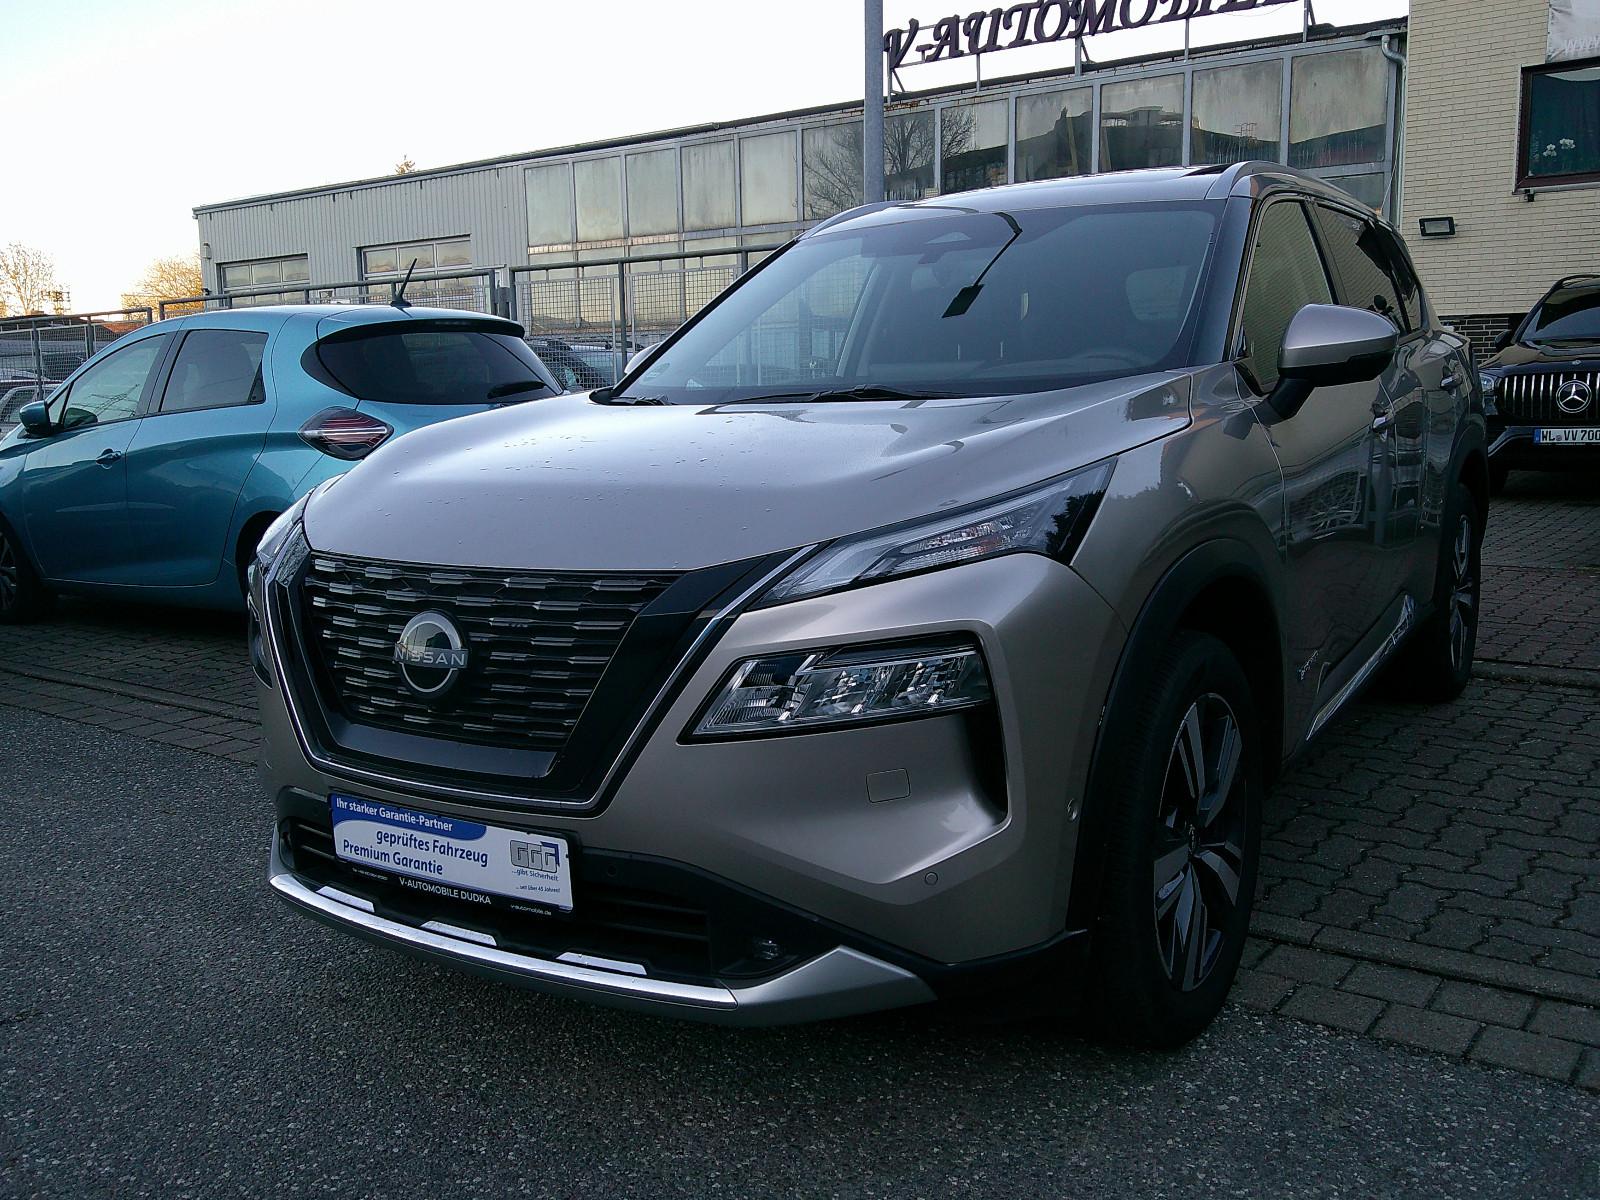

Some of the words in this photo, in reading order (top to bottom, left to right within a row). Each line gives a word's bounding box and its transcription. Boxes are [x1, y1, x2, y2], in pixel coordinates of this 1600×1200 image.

[1564, 429, 1578, 441] VV
[395, 645, 465, 666] NISSAN
[336, 797, 347, 808] Ihr
[349, 801, 378, 816] starker
[379, 807, 453, 832] Garantie-Partner
[343, 839, 390, 863] Premium
[393, 852, 443, 875] Garantie
[376, 830, 430, 852] geprüftes
[432, 839, 488, 868] Fahrzeug
[399, 877, 459, 898] V-AUTOMOBILE
[460, 890, 492, 905] DUDKA
